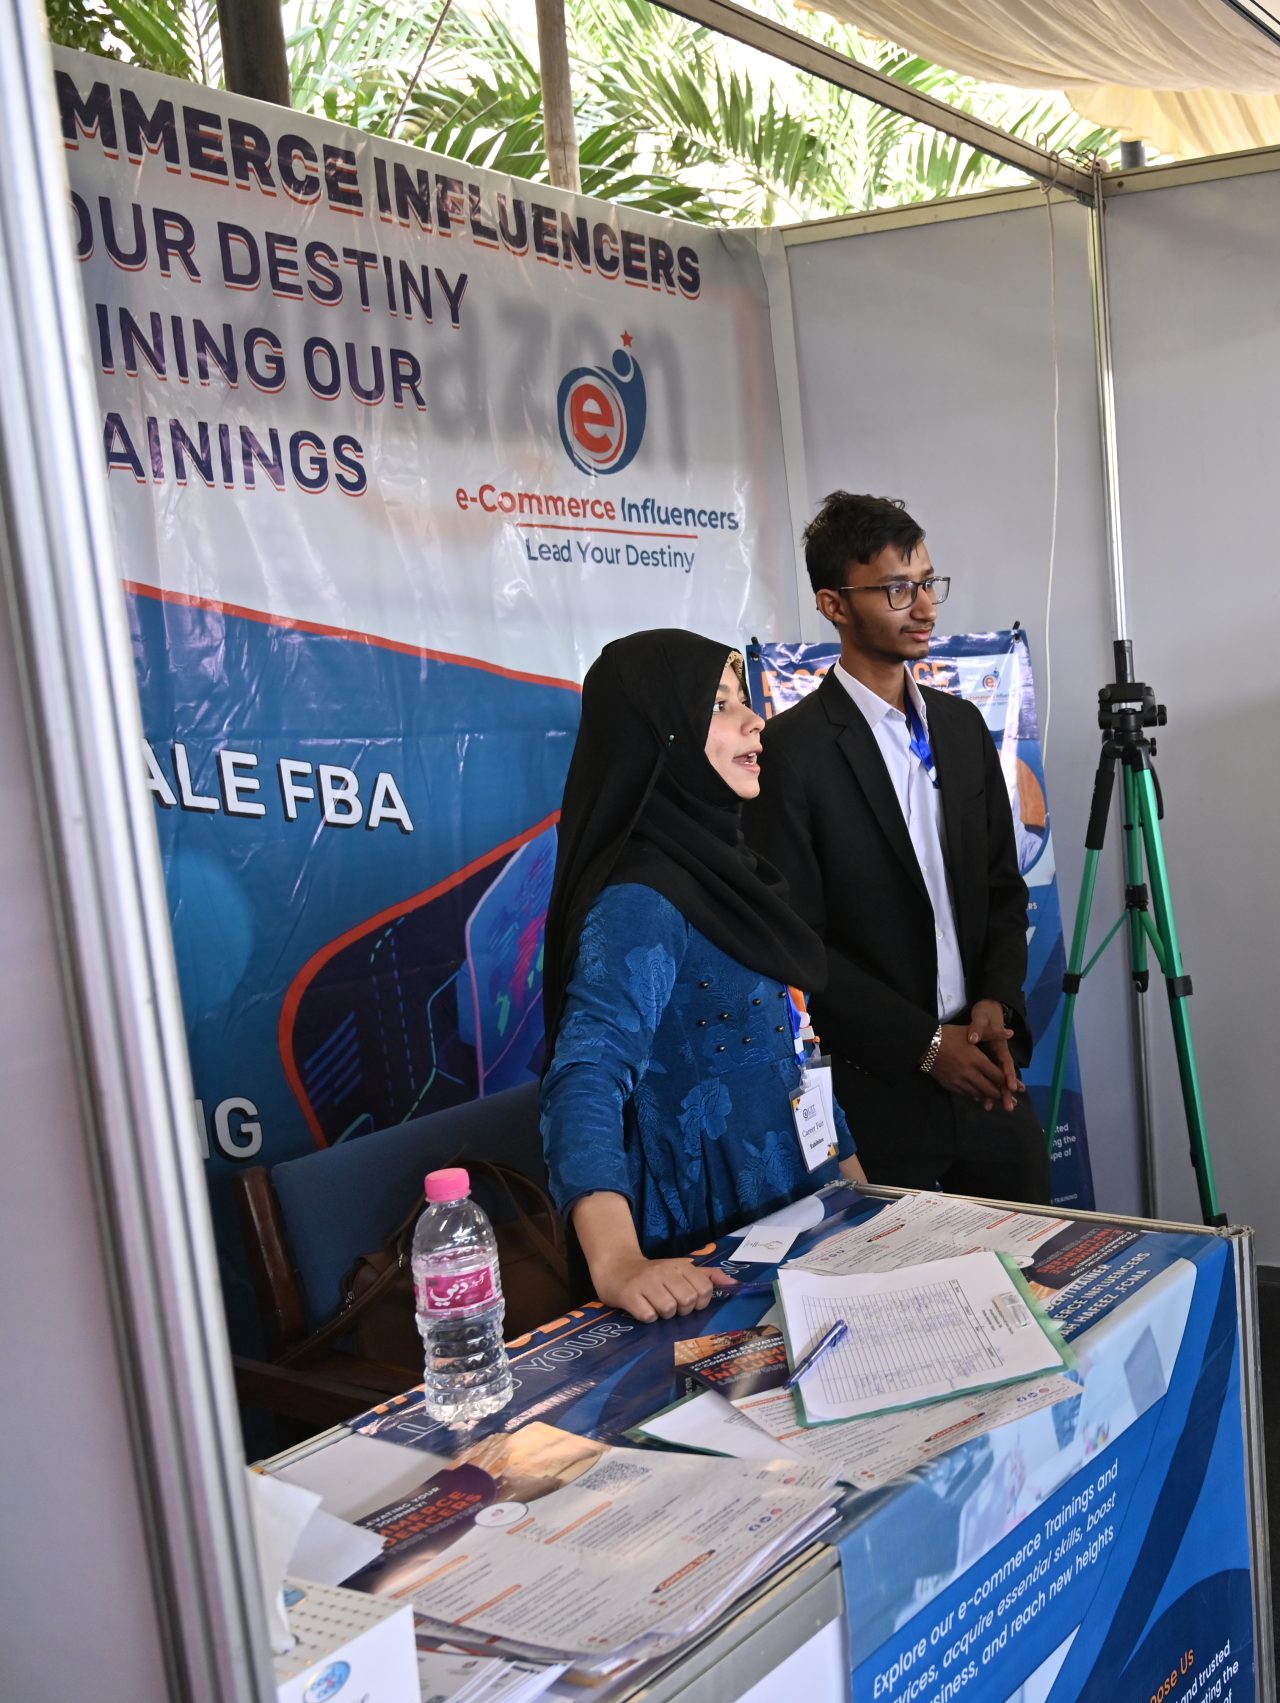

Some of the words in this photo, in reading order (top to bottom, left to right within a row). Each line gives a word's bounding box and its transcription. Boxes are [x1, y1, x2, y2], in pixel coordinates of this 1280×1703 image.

[374, 157, 701, 300] INFLUENCERS
[217, 221, 469, 329] DESTINY
[303, 336, 427, 411] OUR
[455, 484, 616, 521] e-Commerce
[621, 497, 739, 530] Influencers
[525, 538, 572, 562] Lead
[577, 541, 621, 565] Your
[626, 544, 695, 573] Destiny
[279, 758, 414, 833] FBA
[1063, 1135, 1077, 1144] the
[1081, 1251, 1150, 1298] INFLUENCERS
[1073, 1292, 1119, 1322] HAFEEZ
[515, 1322, 634, 1373] YOUR
[409, 1486, 441, 1502] YOUR
[873, 1638, 927, 1699] Explore
[930, 1608, 960, 1645] our
[958, 1533, 1041, 1620] e-commerce
[1045, 1483, 1095, 1539] Trainings
[1097, 1458, 1118, 1492] and
[942, 1610, 994, 1667] acquire
[997, 1551, 1052, 1616] essential
[1053, 1527, 1083, 1563] skills,
[1086, 1491, 1116, 1532] boost
[982, 1628, 1007, 1665] and
[1011, 1592, 1046, 1637] reach
[1050, 1566, 1072, 1601] new
[1075, 1525, 1114, 1575] heights
[1180, 1648, 1194, 1675] Us
[1199, 1639, 1231, 1687] trusted
[1222, 1661, 1239, 1684] the
